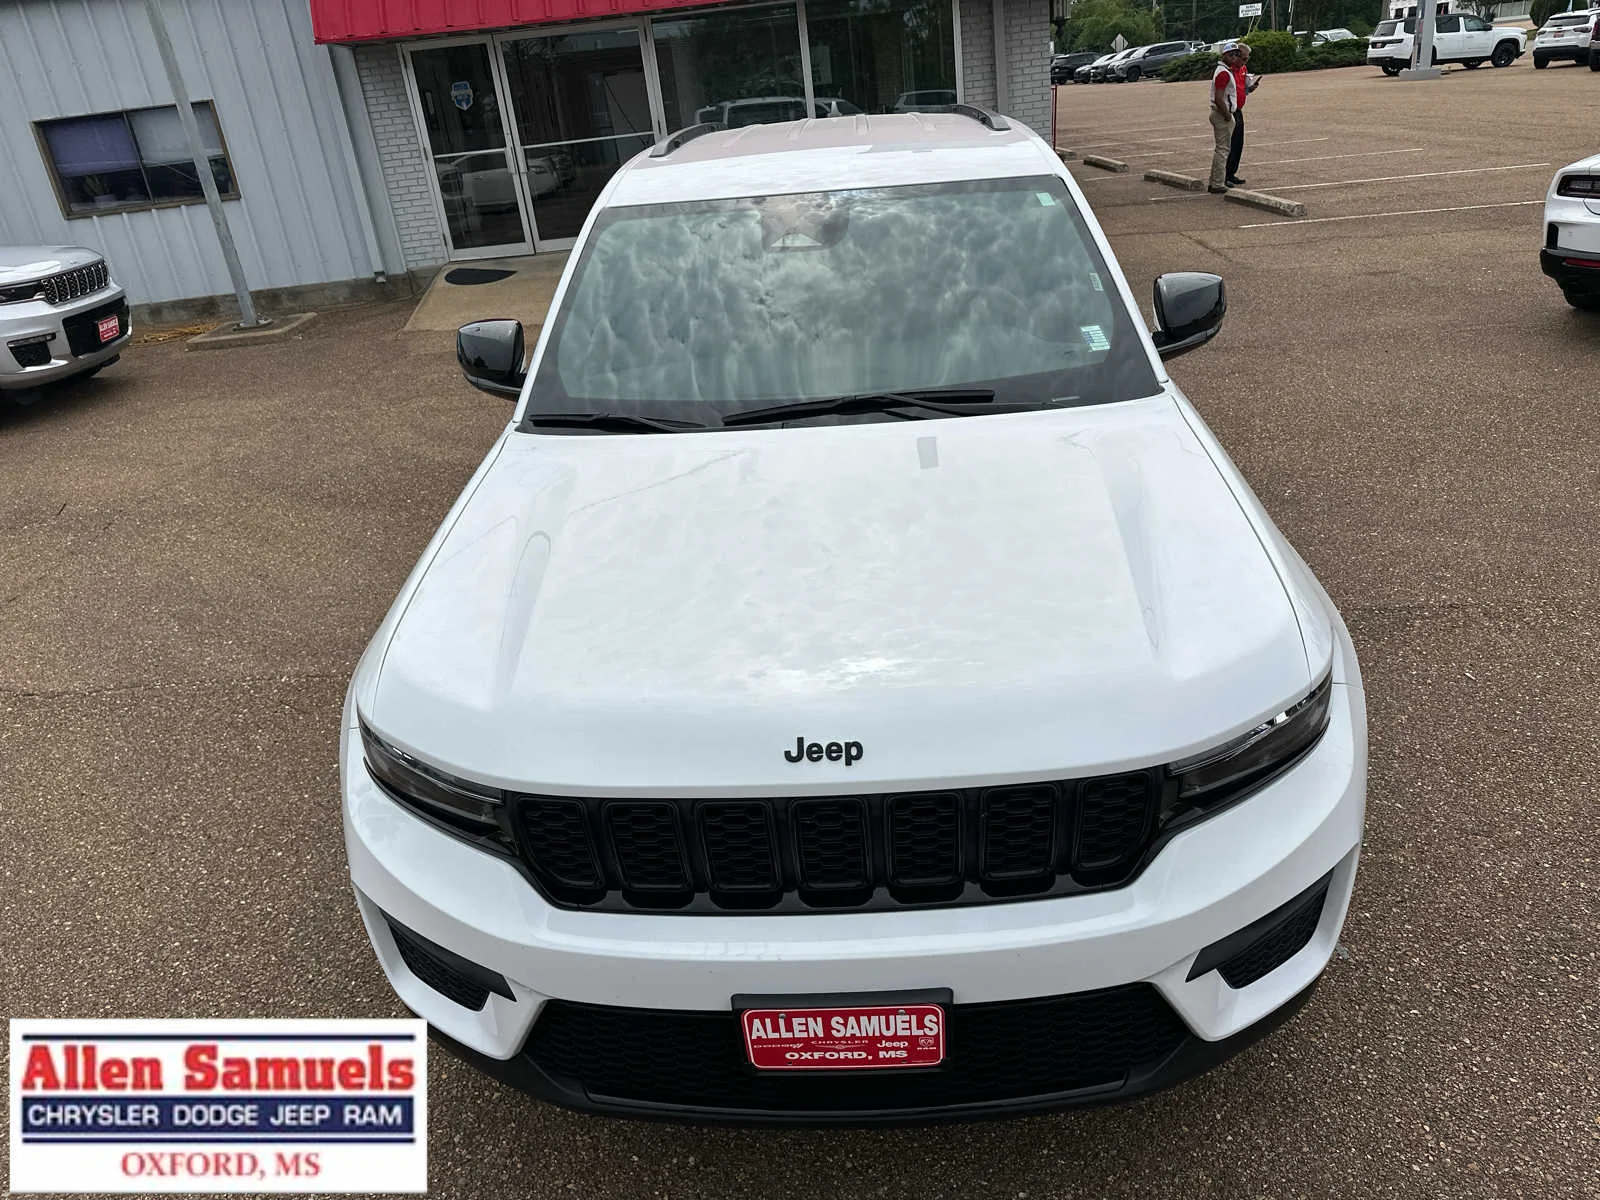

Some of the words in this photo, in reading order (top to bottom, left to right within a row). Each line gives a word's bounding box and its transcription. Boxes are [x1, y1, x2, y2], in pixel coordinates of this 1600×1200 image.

[784, 736, 863, 766] Jeep
[751, 1016, 824, 1040] ALLEN
[830, 1014, 939, 1038] SAMUELS
[876, 1040, 909, 1048] Jeep
[785, 1051, 873, 1060] OXFORD,
[878, 1050, 908, 1058] MS
